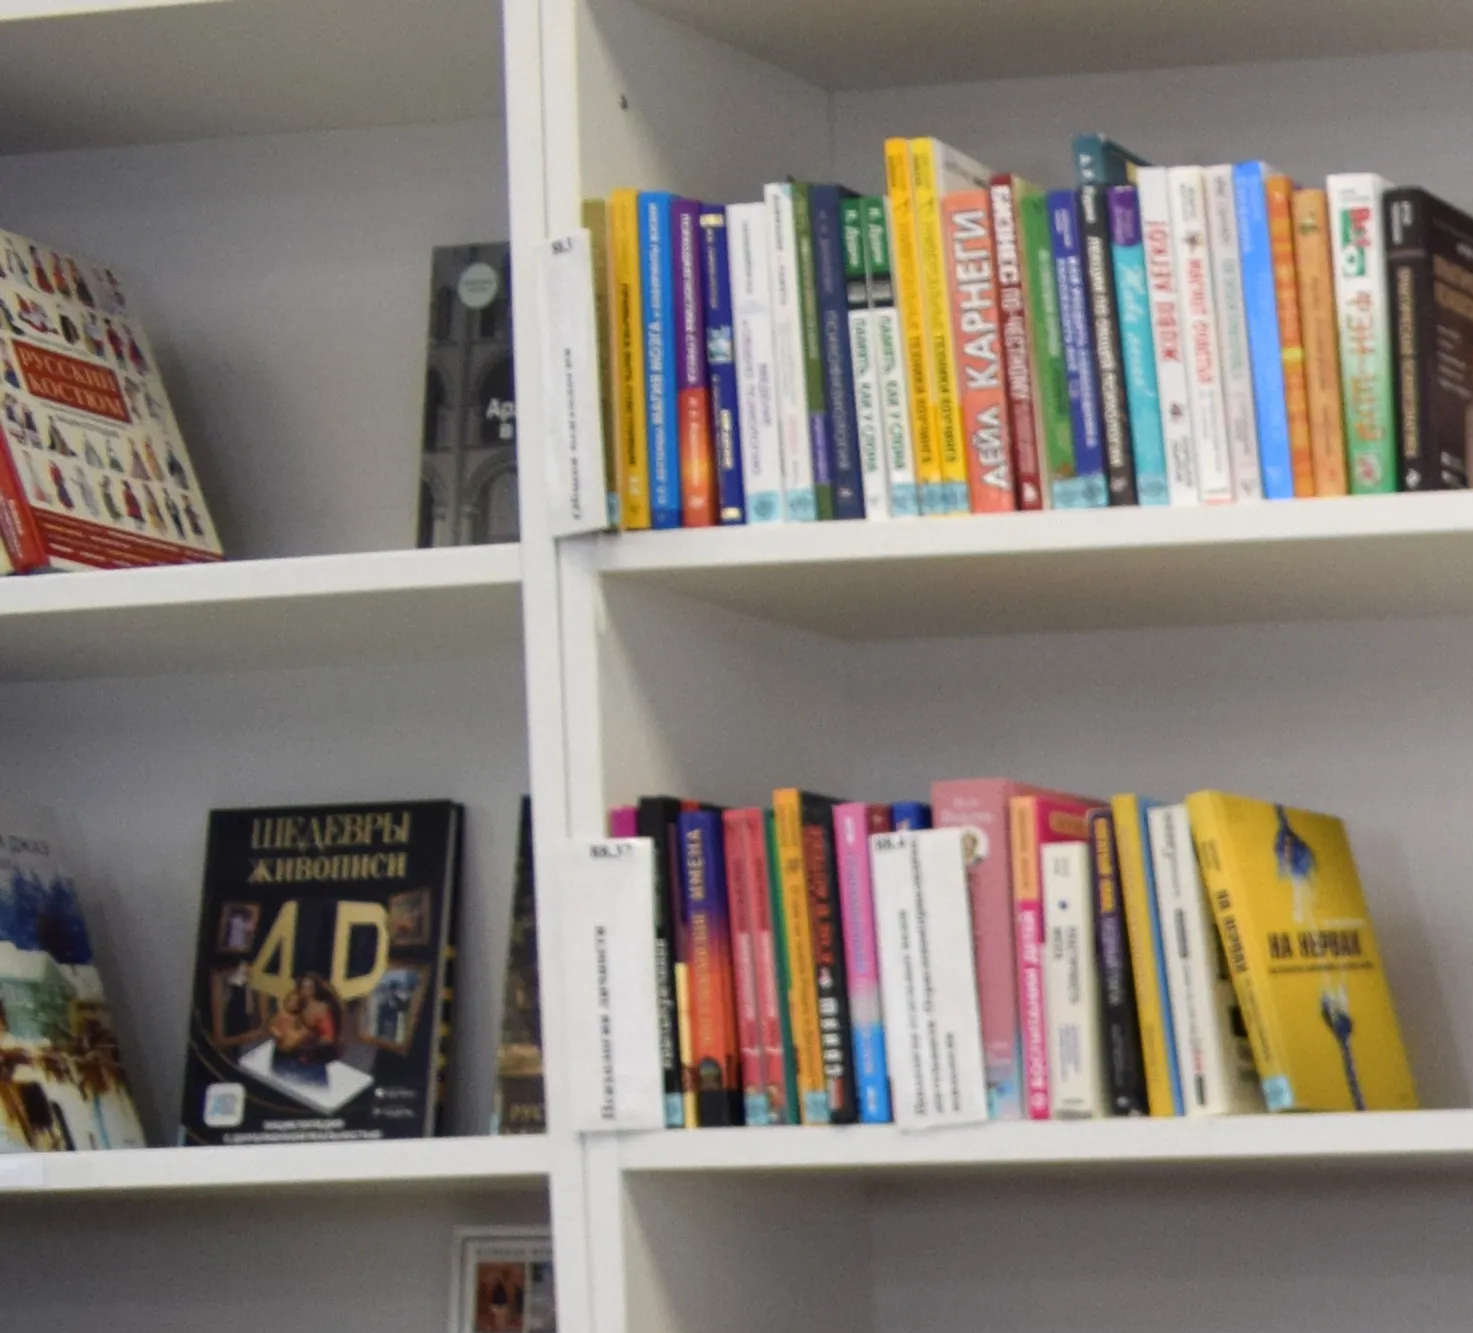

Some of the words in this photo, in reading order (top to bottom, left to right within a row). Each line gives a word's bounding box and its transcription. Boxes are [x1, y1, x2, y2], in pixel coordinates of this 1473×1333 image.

[991, 184, 1015, 285] БИЗНЕС
[950, 210, 1000, 389] КАРНЕГИ
[648, 321, 662, 370] МОЗГА
[650, 374, 664, 423] МАГИЯ
[251, 811, 413, 850] ШЕДЕВРЫ
[247, 853, 407, 885] ЖИВОПИСИ
[686, 828, 706, 902] ИМЕНА
[1268, 931, 1293, 959] НА
[1299, 930, 1362, 957] НЕРВАХ
